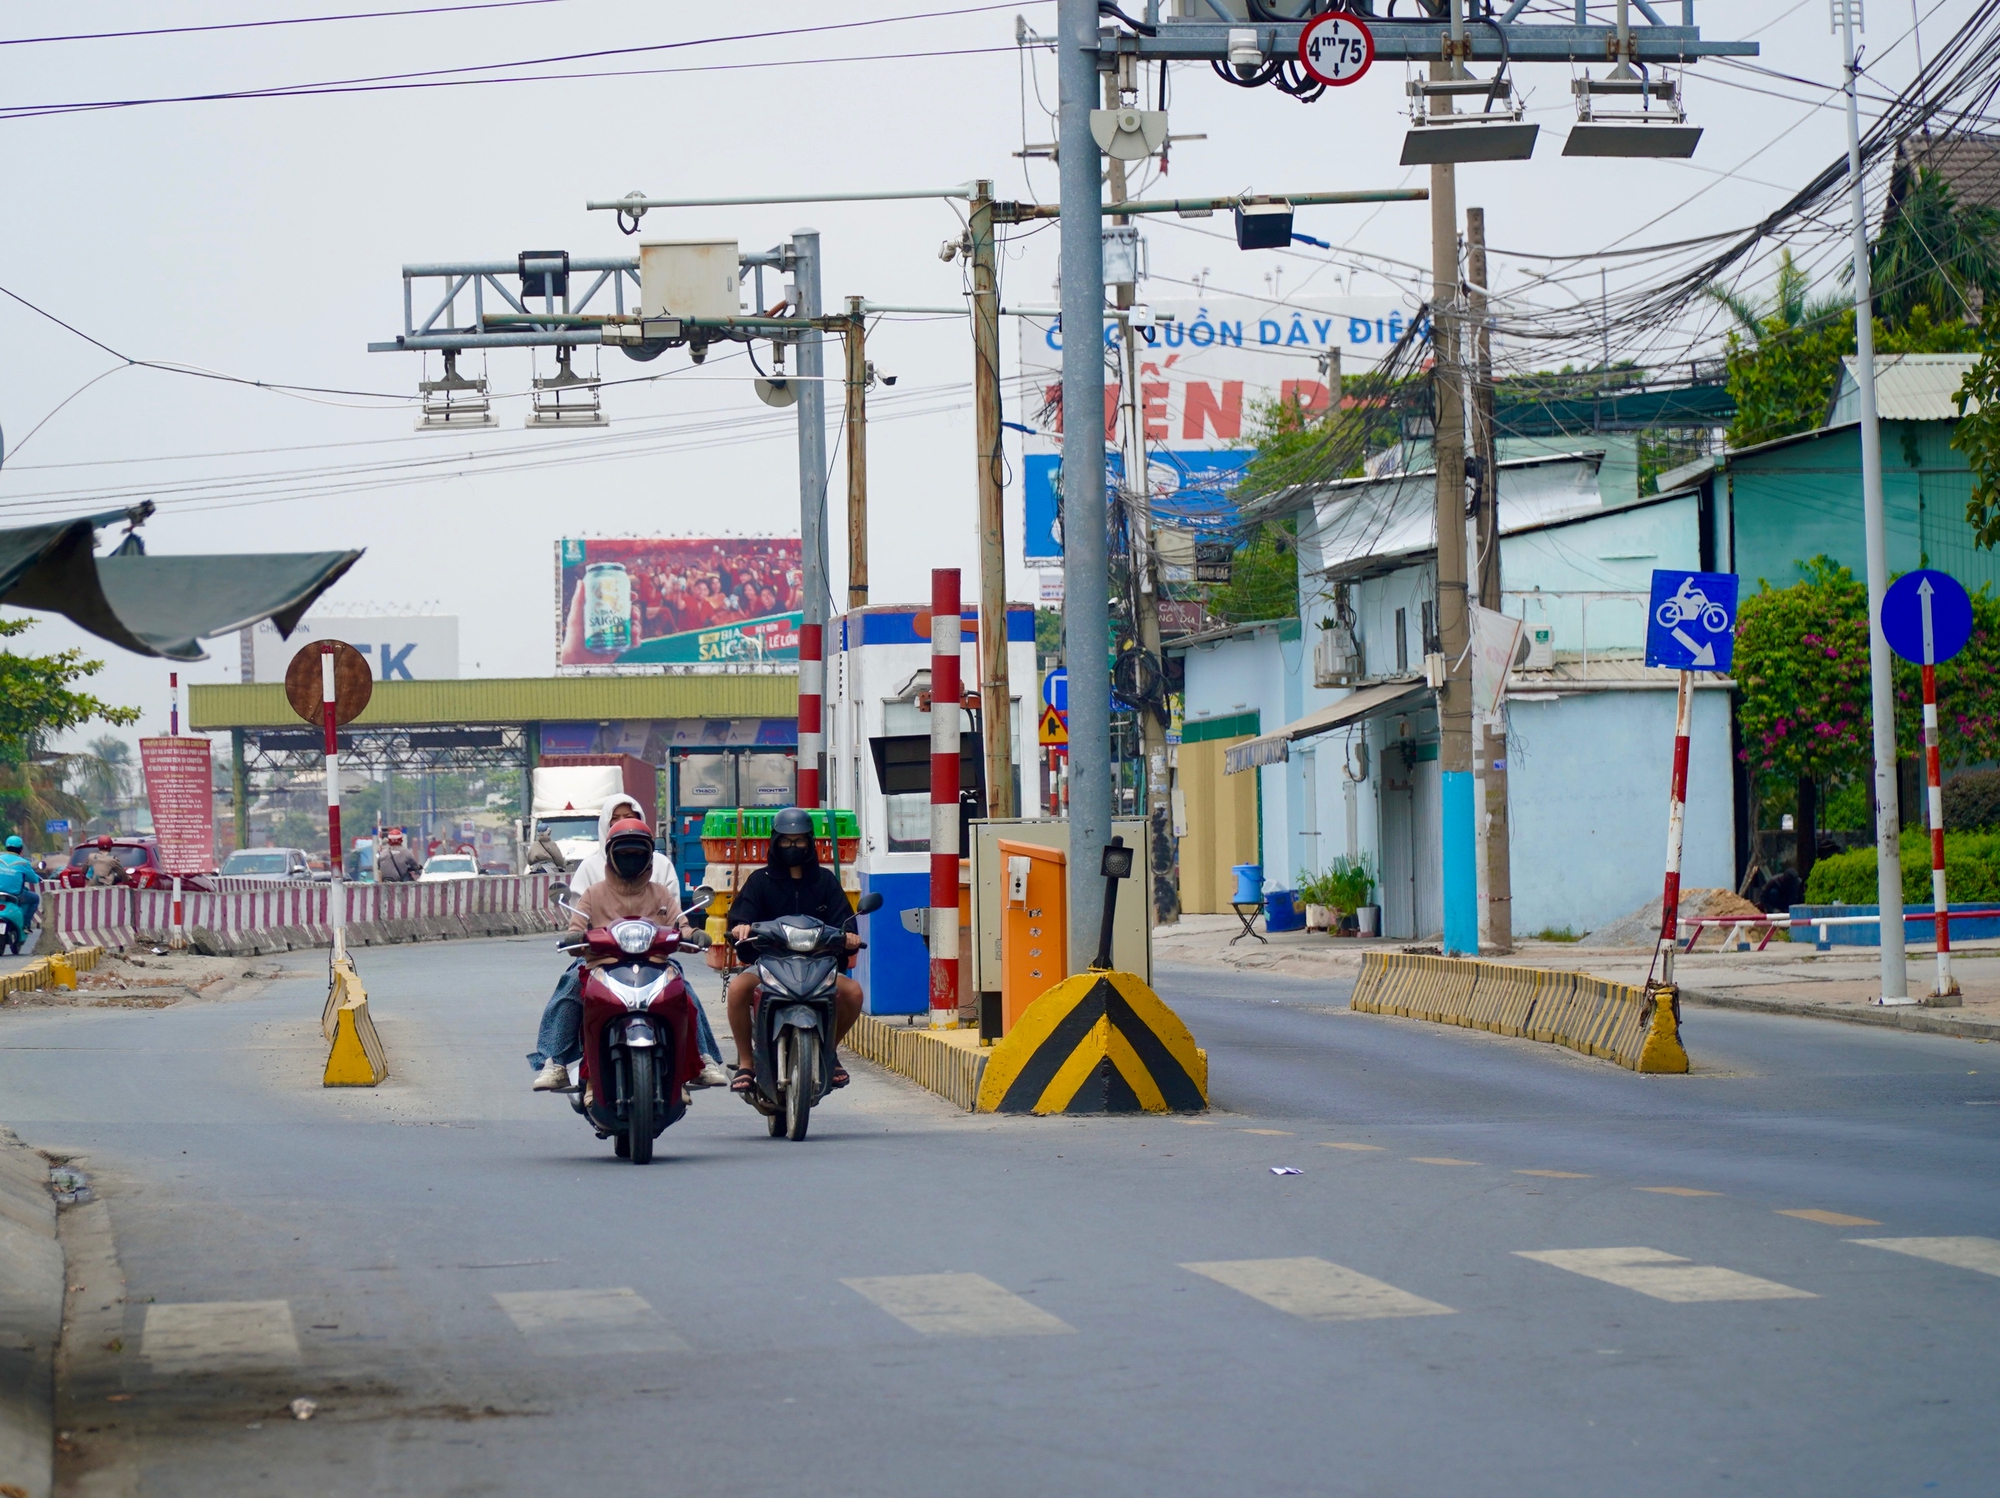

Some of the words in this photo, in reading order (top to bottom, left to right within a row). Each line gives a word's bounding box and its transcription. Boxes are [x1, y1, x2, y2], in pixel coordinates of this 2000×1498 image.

[1147, 307, 1243, 348] LUỒN
[1259, 311, 1333, 346] DÂY
[720, 627, 741, 641] BIA
